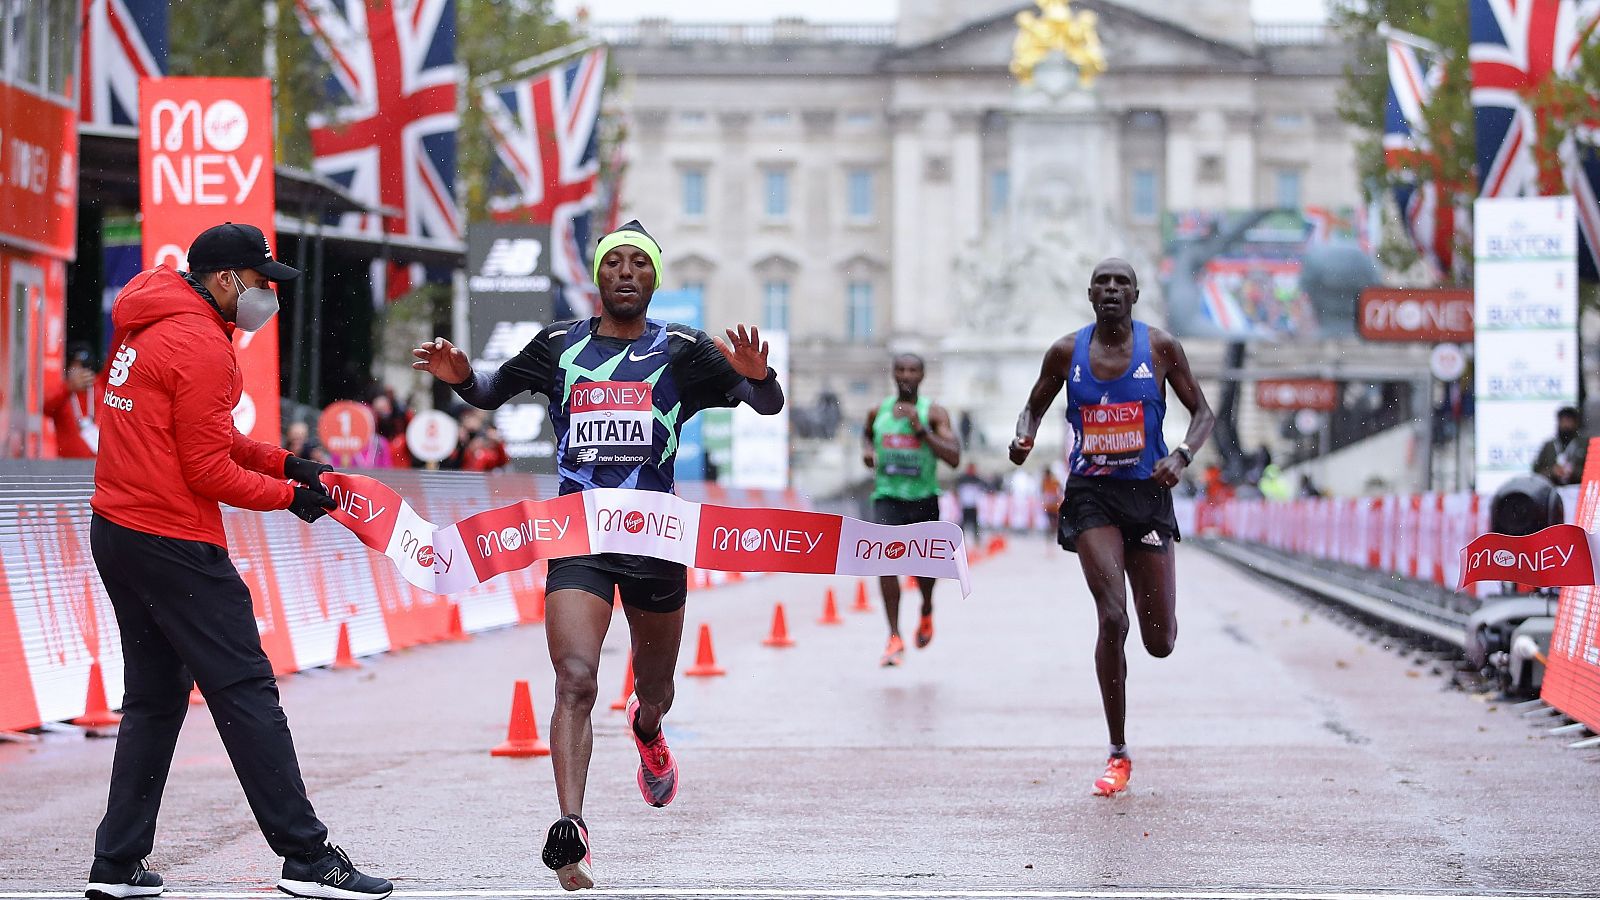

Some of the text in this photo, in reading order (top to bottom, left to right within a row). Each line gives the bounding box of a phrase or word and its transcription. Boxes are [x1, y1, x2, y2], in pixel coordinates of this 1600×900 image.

[152, 153, 263, 205] NEY
[573, 387, 648, 407] MONEY
[336, 412, 352, 435] 1
[1083, 406, 1139, 423] MONEY
[576, 420, 645, 443] KITATA
[1083, 431, 1143, 452] KIPCHUMBA
[614, 454, 644, 462] balance
[597, 508, 686, 541] MONEY
[624, 514, 644, 531] Virgin
[476, 515, 570, 559] MONEY
[712, 526, 823, 554] MONEY
[743, 532, 760, 549] Virgin
[886, 544, 905, 557] Virgin
[1468, 544, 1574, 573] MONEY
[1494, 551, 1515, 565] Virgin
